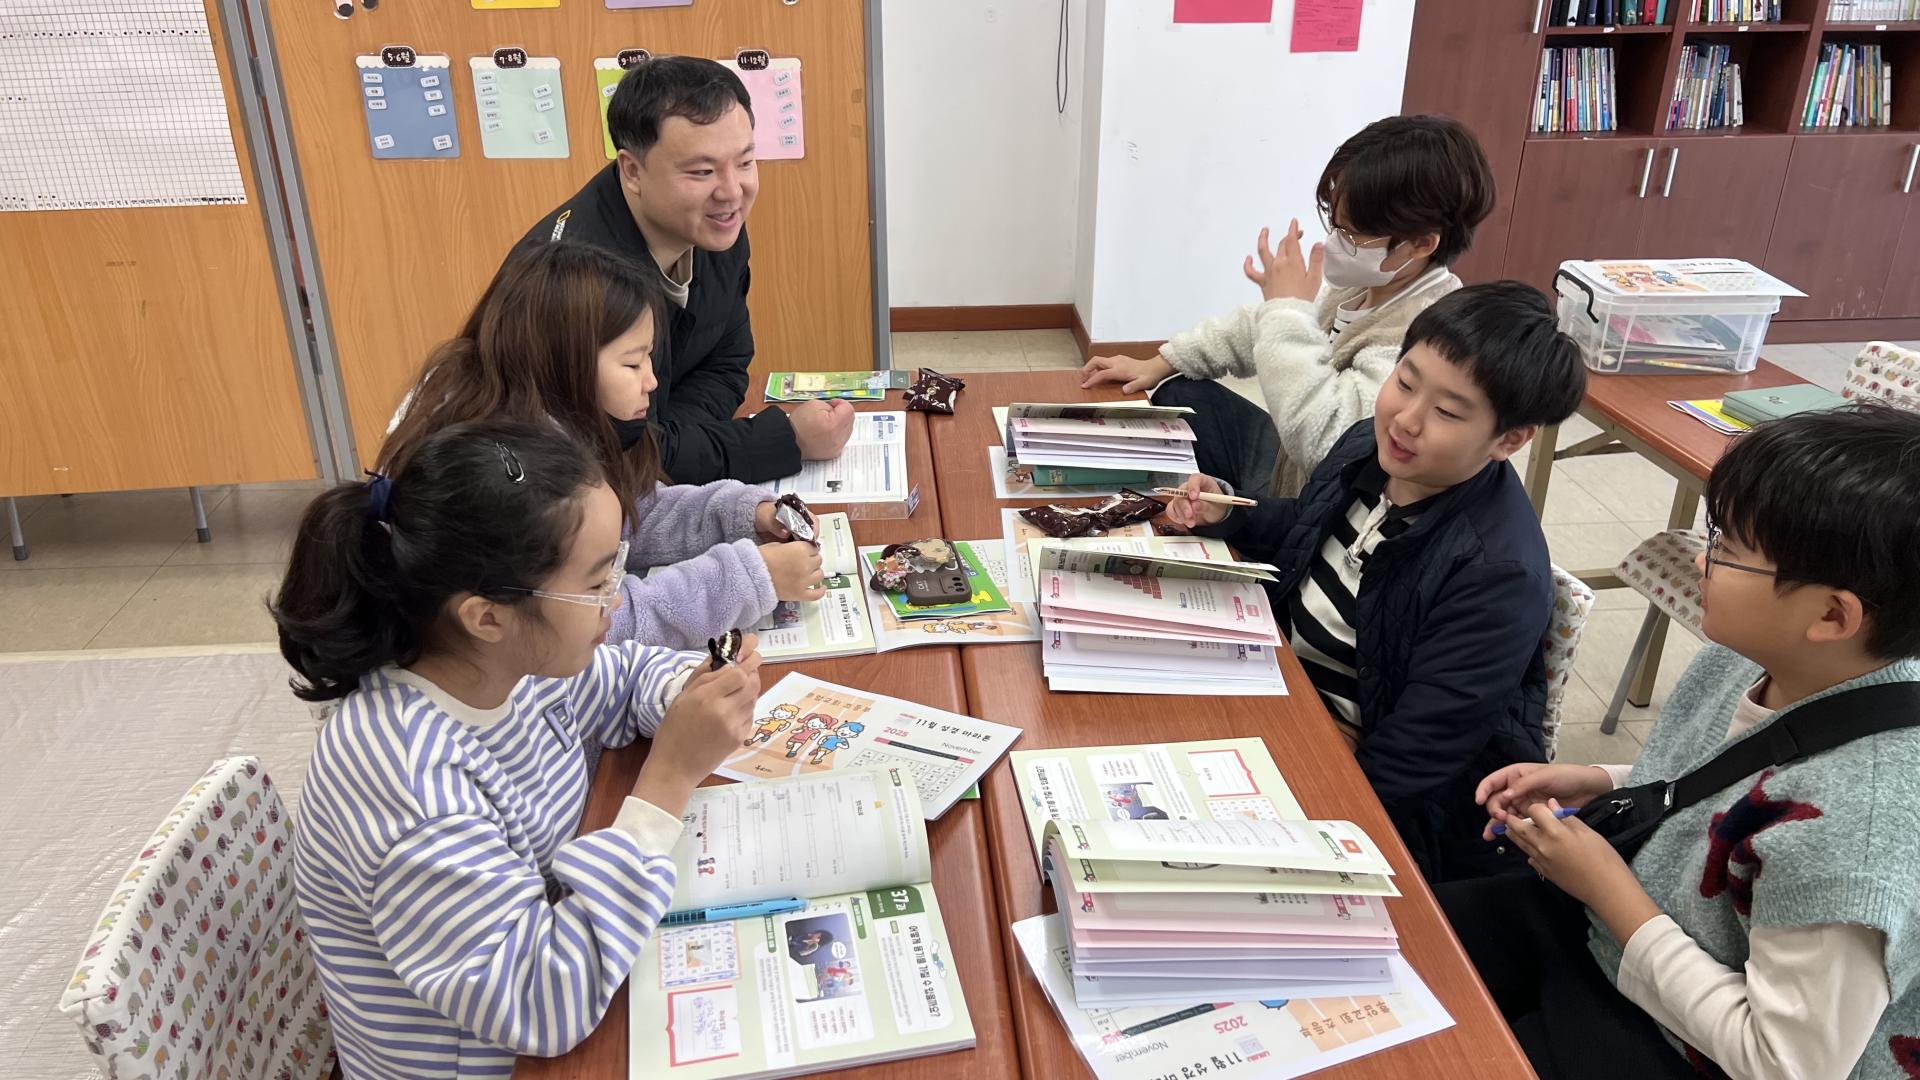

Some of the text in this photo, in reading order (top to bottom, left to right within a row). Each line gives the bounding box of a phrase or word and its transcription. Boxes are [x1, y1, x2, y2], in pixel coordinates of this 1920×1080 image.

[883, 726, 910, 738] 2025
[916, 718, 991, 742] 11월 성경 마라톤
[941, 742, 981, 754] November
[891, 889, 911, 911] 37과
[1213, 1015, 1248, 1034] 2025
[1299, 1000, 1391, 1038] 후암교회 초등부
[1115, 1040, 1169, 1063] November
[1210, 1051, 1243, 1069] 11월
[1181, 1062, 1208, 1079] 성경
